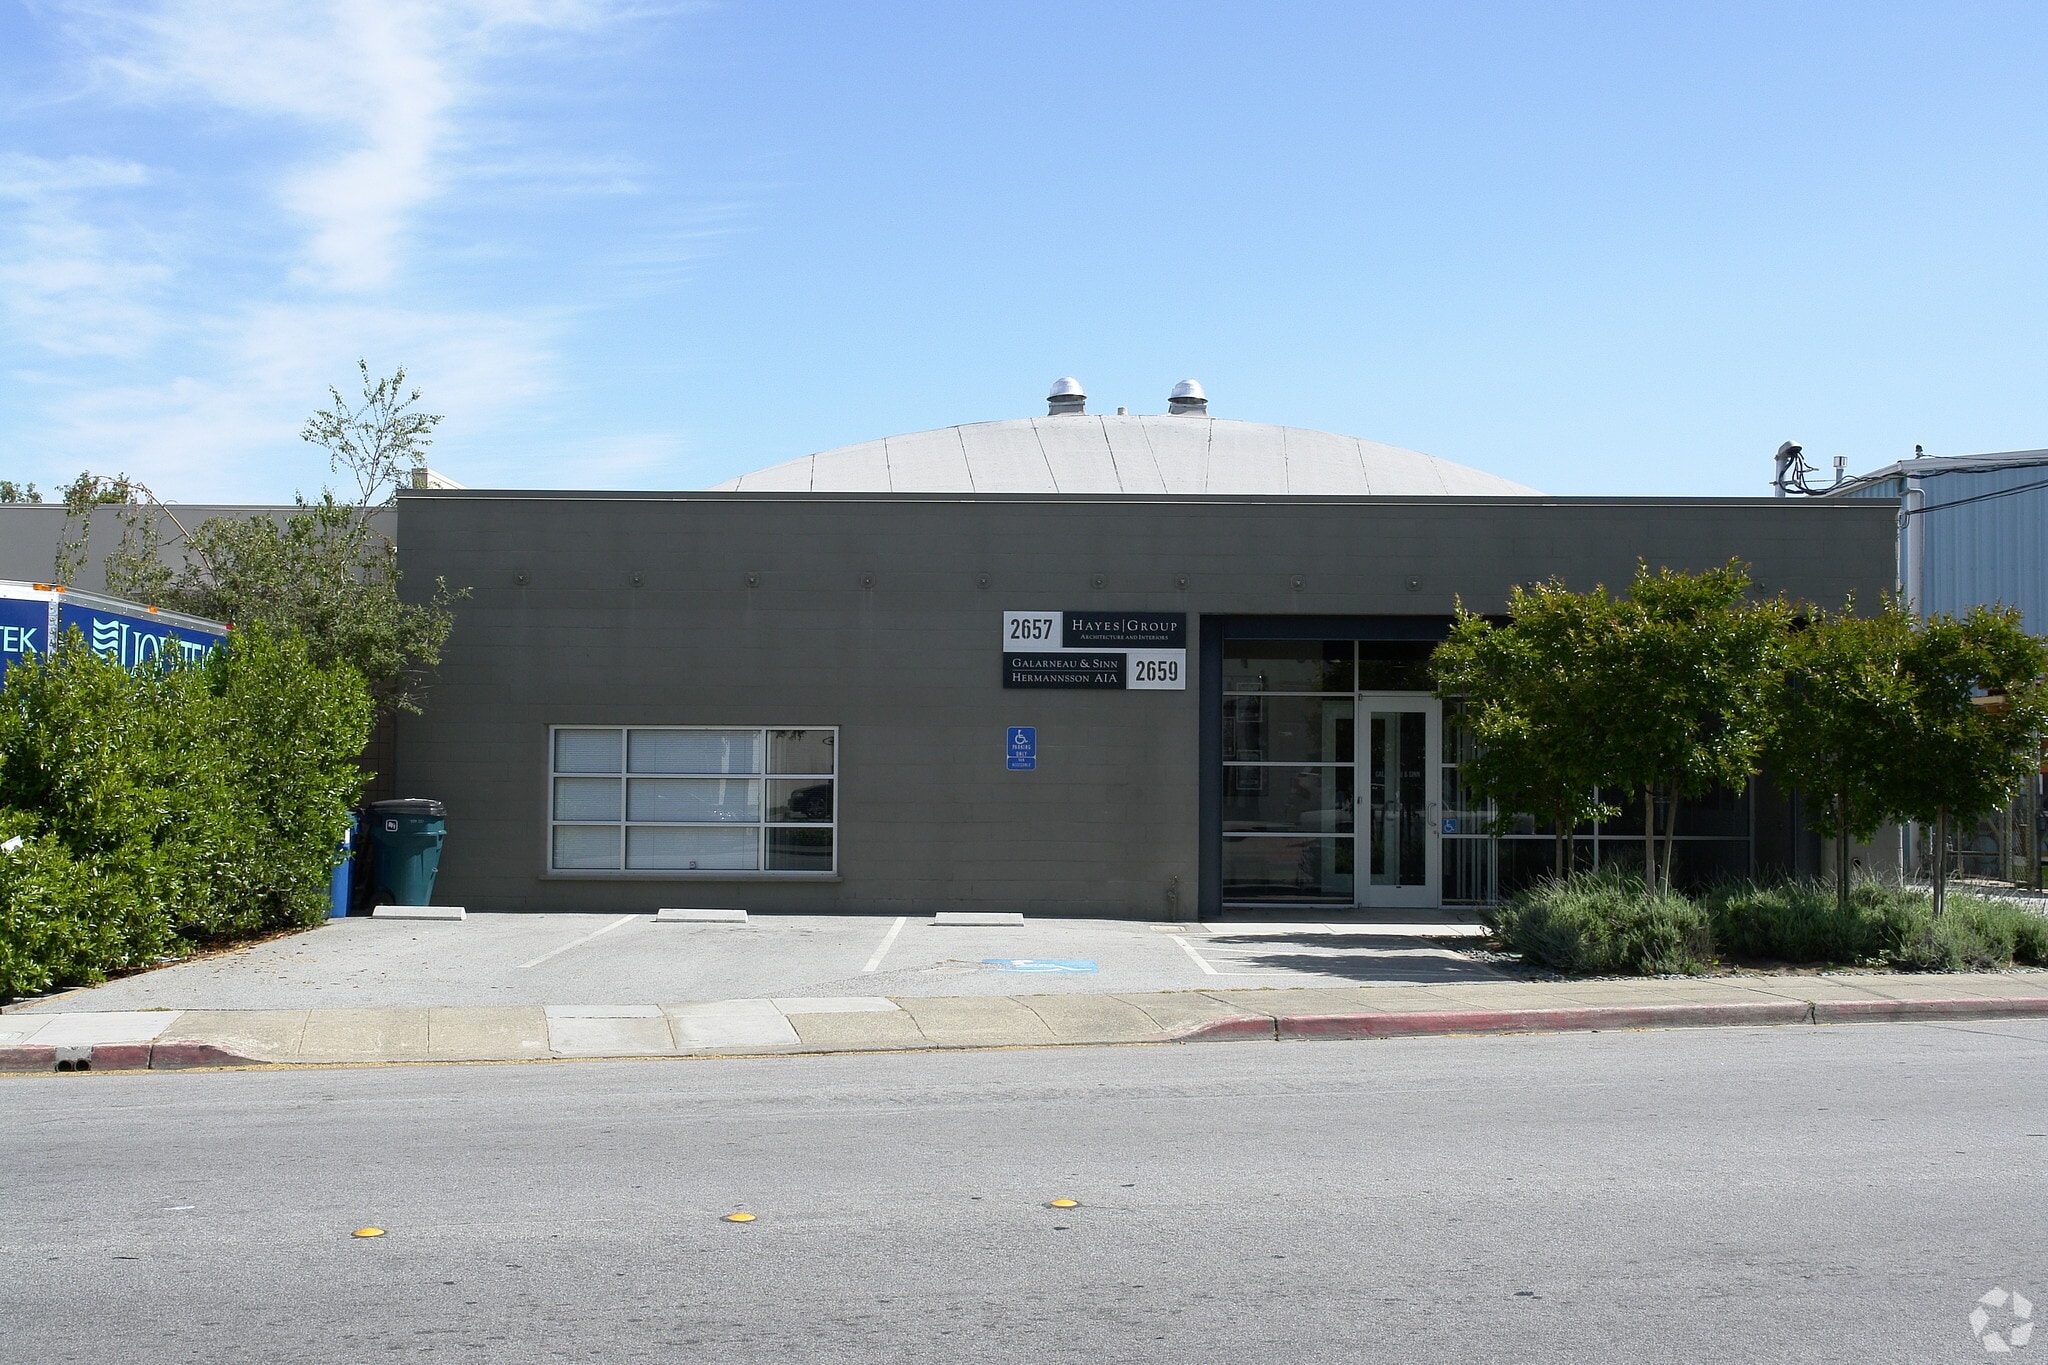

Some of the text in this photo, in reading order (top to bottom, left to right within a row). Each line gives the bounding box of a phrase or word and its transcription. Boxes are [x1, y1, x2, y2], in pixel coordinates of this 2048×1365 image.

[0, 625, 38, 654] EK
[1010, 618, 1053, 640] 2657
[1080, 658, 1090, 668] &
[1135, 660, 1178, 682] 2659
[1094, 673, 1118, 683] AIA
